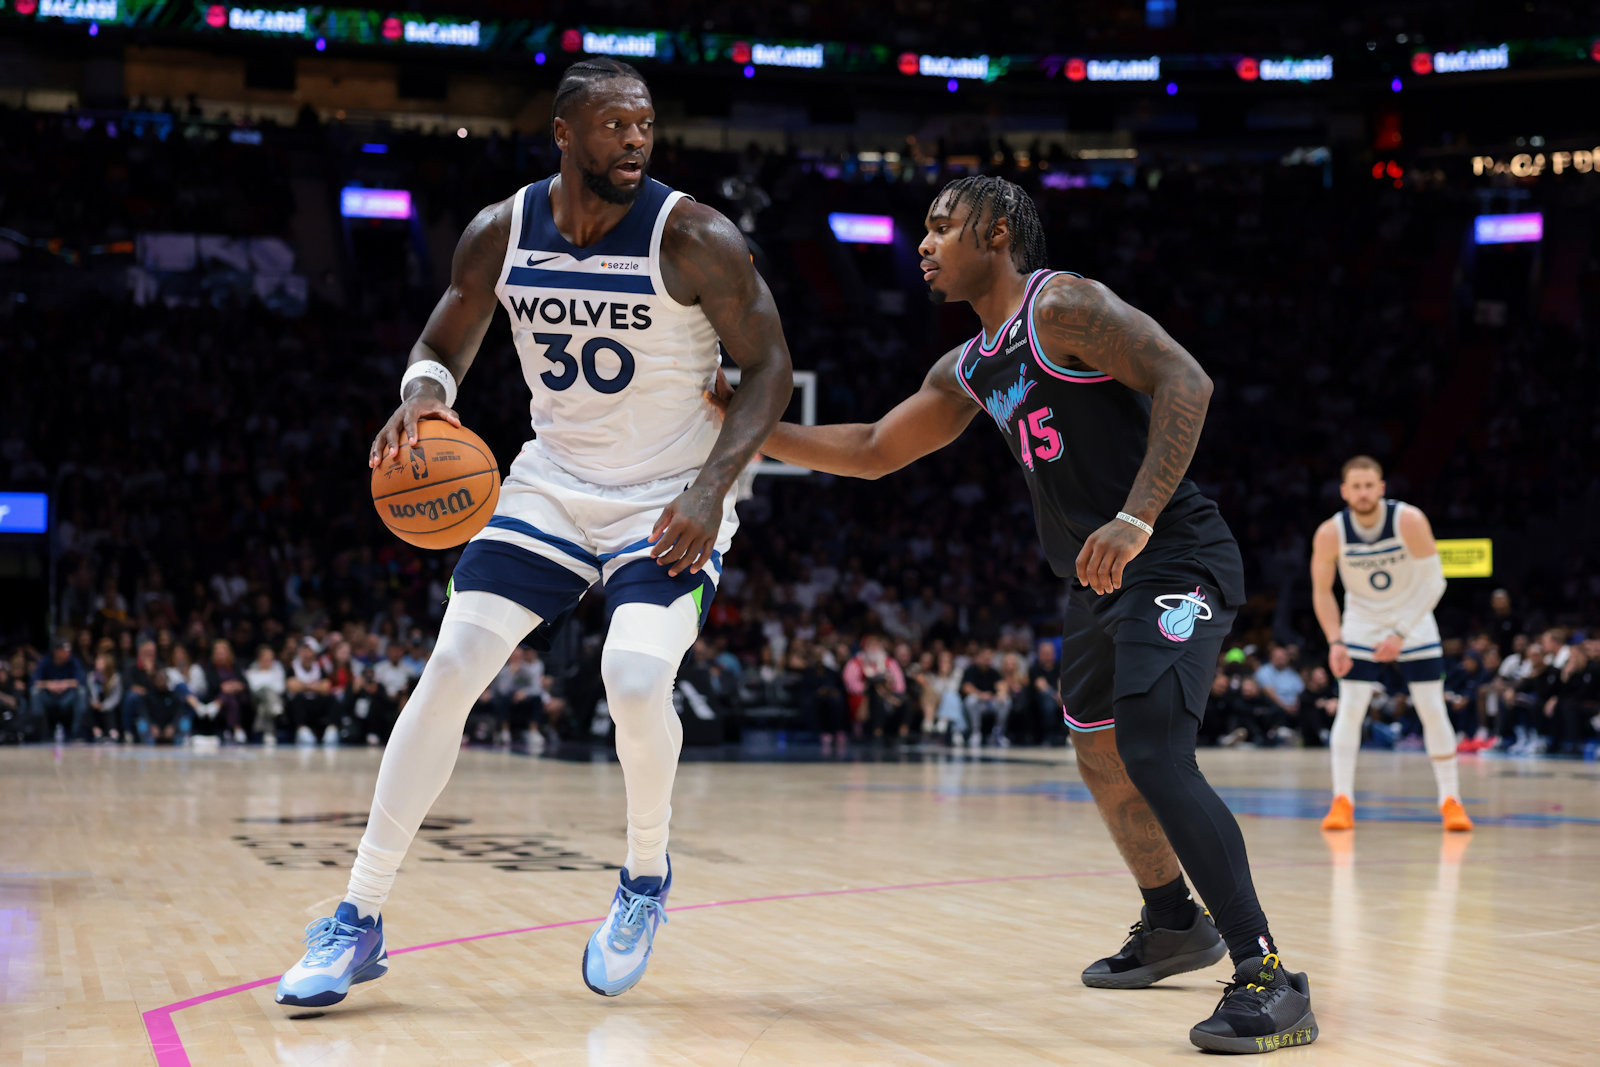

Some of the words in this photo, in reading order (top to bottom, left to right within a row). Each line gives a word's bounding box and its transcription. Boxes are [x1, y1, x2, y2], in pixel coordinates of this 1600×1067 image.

[607, 261, 639, 270] sezzle
[508, 296, 652, 330] WOLVES
[532, 332, 635, 394] 30
[1005, 337, 1027, 355] Robinhood
[986, 362, 1038, 435] Miami
[1018, 406, 1064, 472] 45
[388, 487, 475, 521] Wilson
[1370, 570, 1391, 591] 0
